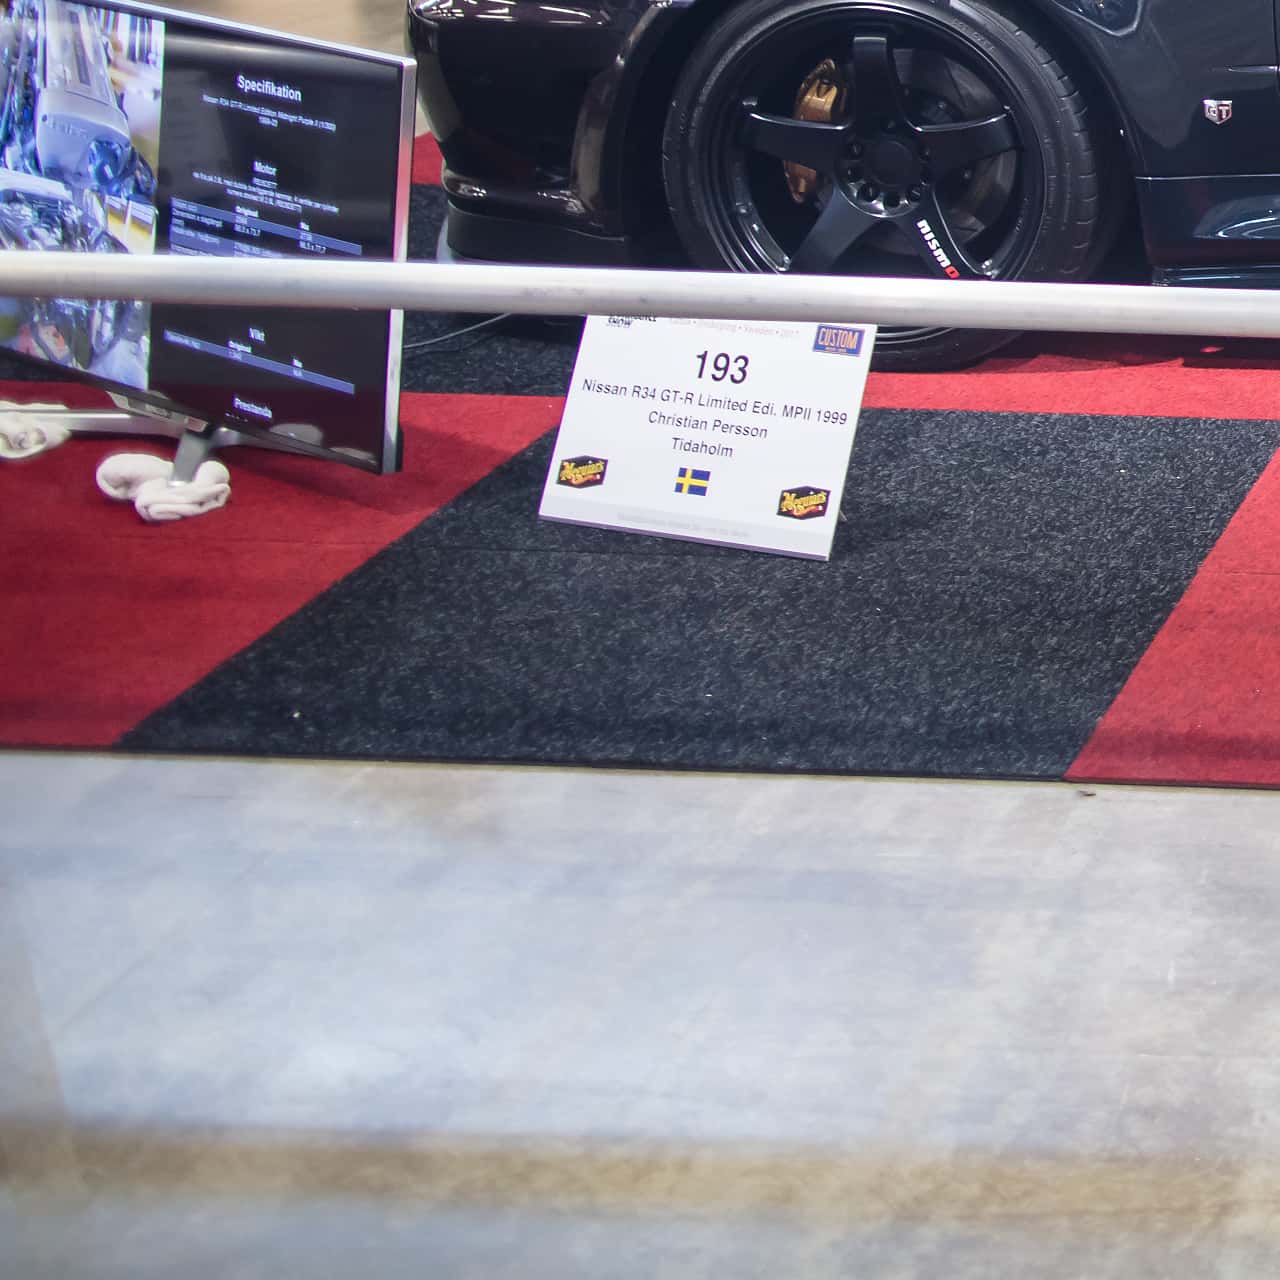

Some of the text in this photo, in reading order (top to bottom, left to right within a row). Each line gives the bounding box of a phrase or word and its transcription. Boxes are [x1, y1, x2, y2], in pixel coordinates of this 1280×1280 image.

[237, 74, 302, 102] Specifikation
[917, 219, 960, 279] nismo
[818, 328, 859, 349] CUSTOM
[696, 350, 750, 385] 193
[582, 378, 628, 397] Nissan
[632, 384, 657, 400] R34
[660, 389, 695, 406] GT-R
[697, 393, 748, 413] Limited
[751, 400, 778, 417] Edi.
[816, 409, 849, 426] 1999
[648, 410, 769, 439] Christian Persson
[671, 437, 734, 458] Tidaholm
